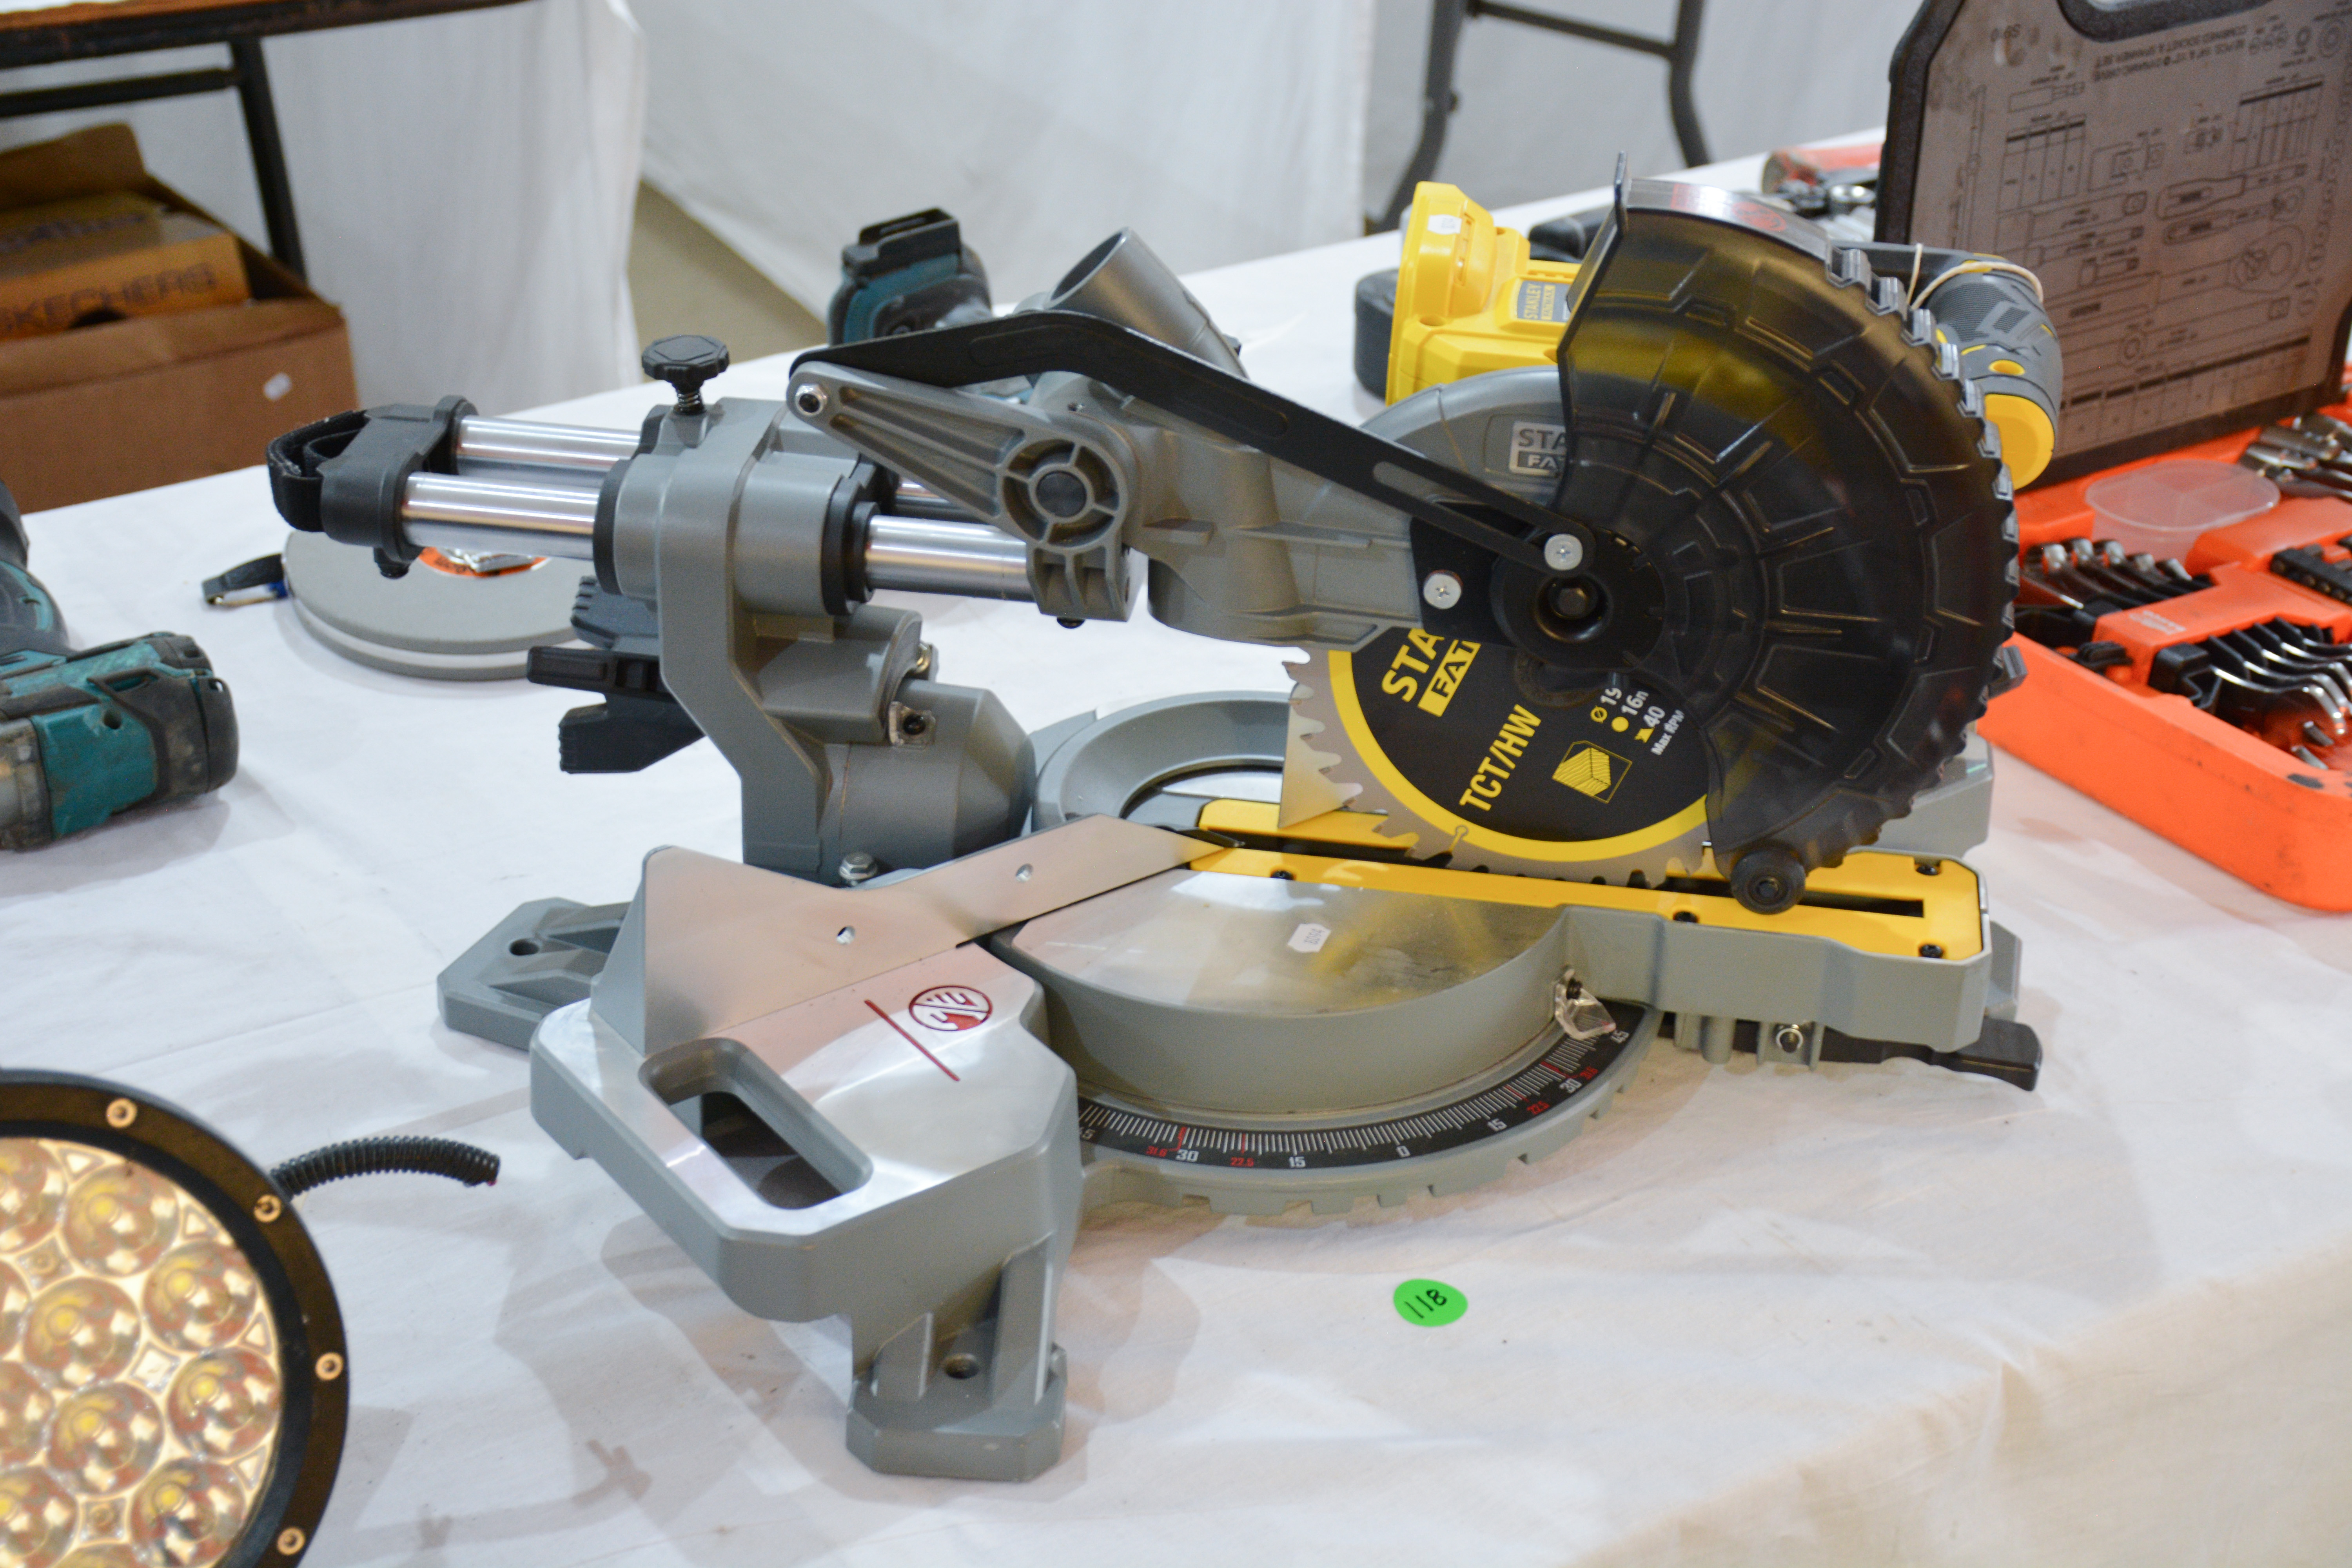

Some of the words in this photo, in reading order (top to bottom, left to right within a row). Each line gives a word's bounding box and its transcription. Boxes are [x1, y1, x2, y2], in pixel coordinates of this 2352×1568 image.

[1523, 283, 1542, 319] STANLEY
[1432, 641, 1477, 697] FAT
[1643, 706, 1665, 728] 40
[1651, 733, 1672, 755] Max
[1663, 709, 1685, 734] RPM
[1459, 704, 1542, 811] TCT/HW
[1610, 1030, 1630, 1044] 45
[1559, 1078, 1582, 1094] 30
[1488, 1118, 1508, 1132] 15
[1176, 1149, 1199, 1162] 30
[1396, 1145, 1410, 1158] 0
[1230, 1157, 1254, 1168] 22.5
[1289, 1156, 1306, 1168] 15
[1403, 1289, 1448, 1319] 118
